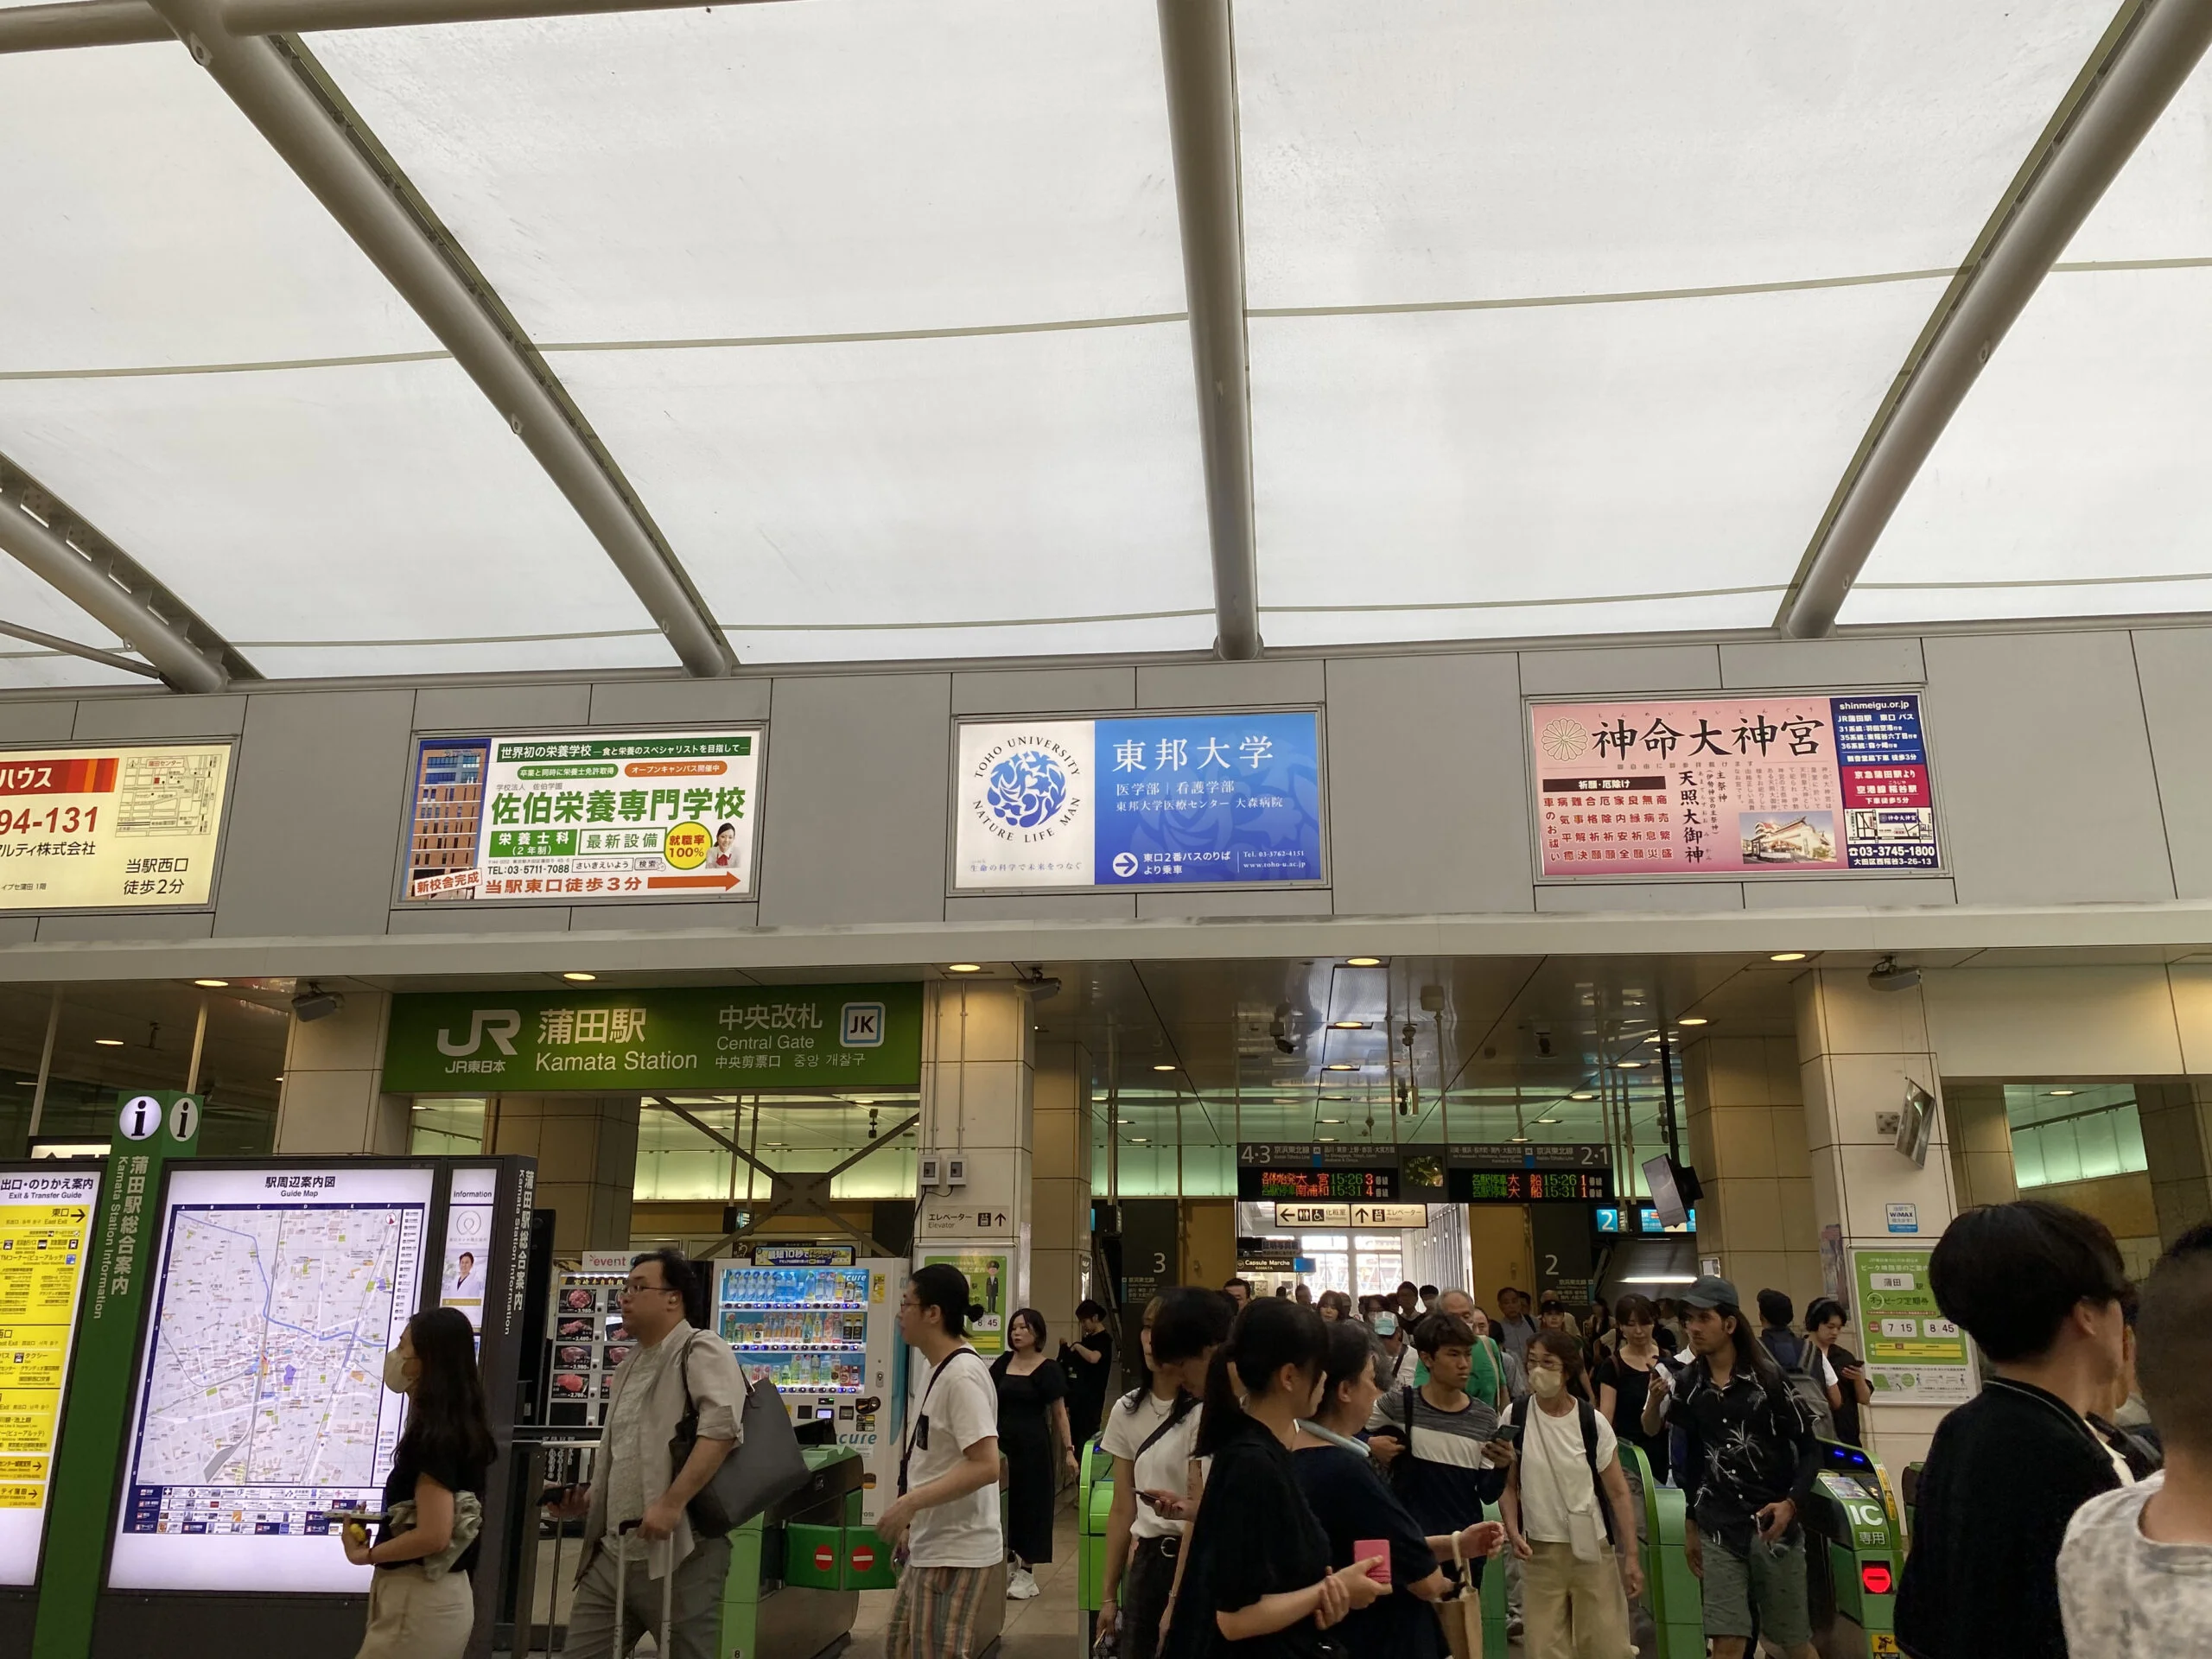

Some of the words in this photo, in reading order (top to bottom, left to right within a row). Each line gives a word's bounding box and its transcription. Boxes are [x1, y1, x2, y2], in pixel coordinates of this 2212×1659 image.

[1840, 701, 1909, 710] shinmeigu.or.jp
[1592, 715, 1824, 760] 神命大神宮
[501, 745, 592, 760] 世界初の栄養学校
[975, 746, 1002, 778] TOHO
[1007, 736, 1080, 776] UNIVERSITY
[1112, 735, 1274, 772] 東邦大学
[520, 767, 614, 777] 卒業と同時に栄養士免許取得
[632, 765, 720, 773] オープンキャンパス開催中
[1854, 770, 1916, 779] 京急蒲田駅より
[1116, 782, 1160, 796] 医学部
[1176, 780, 1235, 795] 看護学部
[1579, 780, 1630, 790] 祈願・厄除け
[1717, 771, 1727, 802] 主祭神
[492, 787, 746, 825] 佐伯栄養専門学校
[1116, 800, 1230, 812] 東邦大学医療センター
[1236, 797, 1283, 809] 大森病院
[973, 800, 1014, 841] NATURE
[1025, 828, 1055, 843] LIFE
[1059, 798, 1081, 826] MAN
[1678, 771, 1704, 864] 天照大御神
[499, 831, 569, 845] 栄養士科
[587, 833, 658, 849] 最新設備
[669, 835, 705, 846] 就職率
[669, 848, 704, 857] 100%
[1143, 851, 1230, 862] 東口2番バスのりば
[1859, 846, 1936, 856] 03-3745-1800
[125, 858, 189, 874] 当駅西口
[575, 861, 629, 869] さいきえいよう
[639, 860, 657, 869] 検索
[1143, 865, 1182, 875] より乗車
[124, 879, 184, 894] 徒歩2分
[416, 872, 480, 893] 新校舎完成
[486, 877, 642, 894] 当駅東口徒歩3分
[719, 1003, 823, 1031] 中央改札
[850, 1016, 874, 1033] JK
[436, 1009, 521, 1057] JR
[537, 1008, 647, 1045] 蒲田駅
[716, 1036, 772, 1051] Central
[778, 1034, 815, 1050] Gate
[445, 1059, 506, 1073] JR東日本
[536, 1052, 616, 1071] Kamata
[624, 1050, 697, 1071] Station
[715, 1055, 781, 1069] 中央剪票口
[794, 1054, 820, 1067] 중앙
[826, 1052, 865, 1067] 개찰구
[1, 1178, 93, 1190] 出口・のりかえ案内
[112, 1156, 129, 1199] Kamata
[264, 1176, 335, 1188] 駅周辺案内図
[1331, 1173, 1363, 1185] 15:26
[1365, 1173, 1373, 1185] 3
[1544, 1174, 1577, 1186] 15:26
[1580, 1174, 1586, 1186] 1
[303, 1190, 319, 1198] Map
[515, 1169, 524, 1215] Kamata
[1296, 1185, 1330, 1197] 南浦和
[1331, 1185, 1362, 1197] 15:31
[1365, 1185, 1374, 1197] 4
[1544, 1186, 1577, 1198] 15:31
[1581, 1186, 1587, 1198] 1
[52, 1208, 70, 1217] 東口
[1601, 1211, 1614, 1230] 2
[105, 1204, 121, 1246] Station
[111, 1156, 149, 1296] 蒲田駅総合案内
[512, 1217, 521, 1261] Station
[513, 1170, 535, 1311] 蒲田駅総合案内
[594, 1256, 626, 1267] event
[1153, 1252, 1166, 1273] 3
[1545, 1254, 1559, 1275] 2
[93, 1249, 113, 1319] Information
[505, 1264, 516, 1335] Information
[839, 1433, 877, 1445] cure
[1848, 1504, 1884, 1526] IC
[1859, 1531, 1885, 1546] 専用
